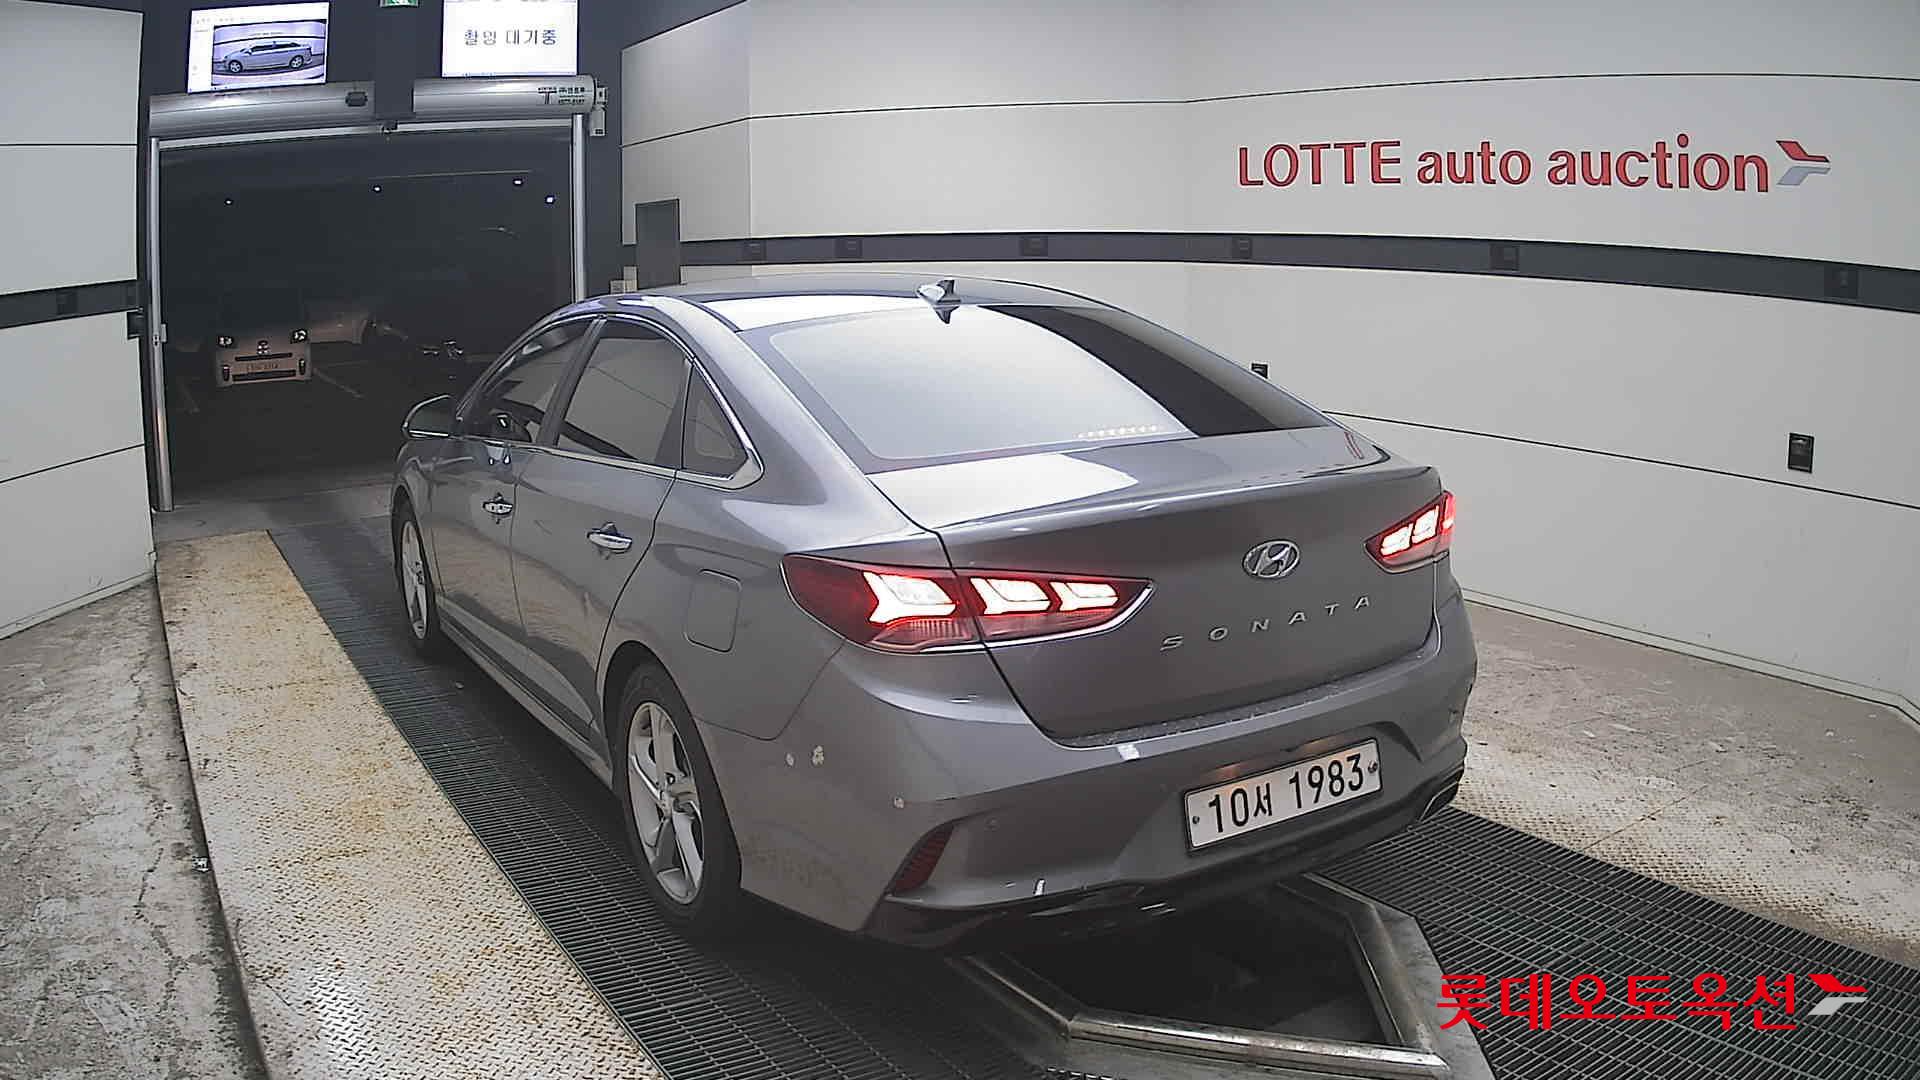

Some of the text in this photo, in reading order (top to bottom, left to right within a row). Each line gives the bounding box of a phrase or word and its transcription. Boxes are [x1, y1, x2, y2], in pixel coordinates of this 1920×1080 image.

[505, 29, 557, 46] 대기중
[1239, 133, 1769, 193] LOTTE auto auction
[1160, 595, 1370, 651] SONATA
[1208, 752, 1365, 833] 10서 1983
